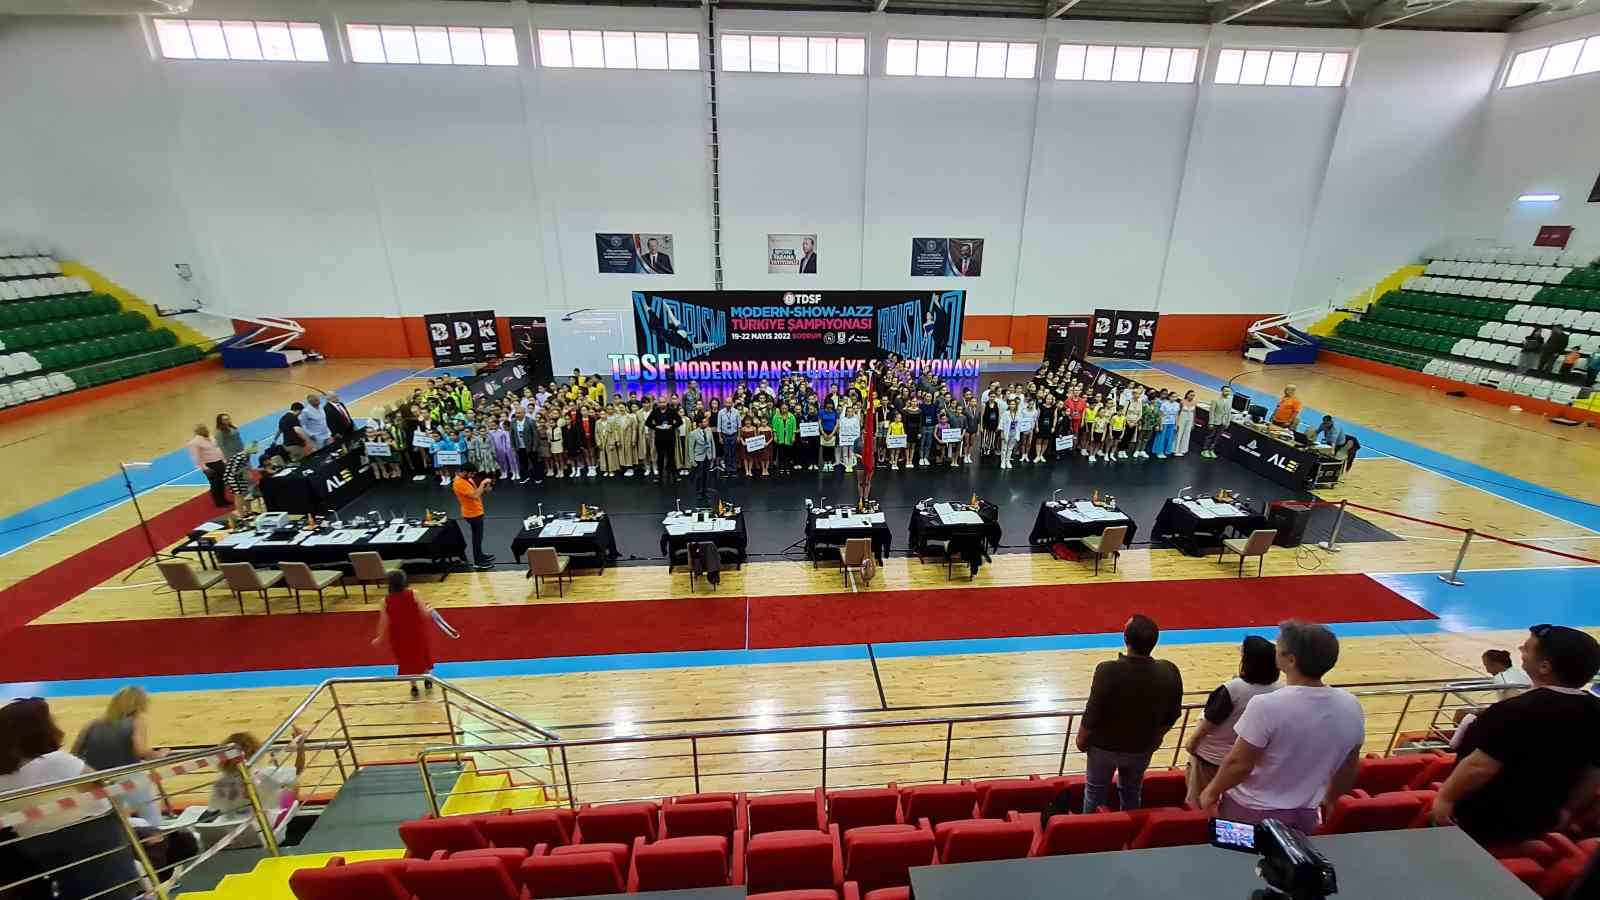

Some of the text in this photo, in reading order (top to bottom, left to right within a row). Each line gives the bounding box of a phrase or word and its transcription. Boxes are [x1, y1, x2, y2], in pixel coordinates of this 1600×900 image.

[796, 294, 822, 304] TDSF
[731, 306, 873, 318] MODERN-SHOW-JAZZ
[731, 317, 872, 331] TÜRKİYE ŞAMPİYONASI
[731, 333, 750, 341] 19-22
[752, 333, 773, 341] MAYIS
[774, 333, 791, 341] 2022
[607, 353, 670, 381] TDSF
[674, 360, 745, 381] MODERN
[747, 360, 793, 380] DANS
[796, 356, 866, 379] TÜRKİYE
